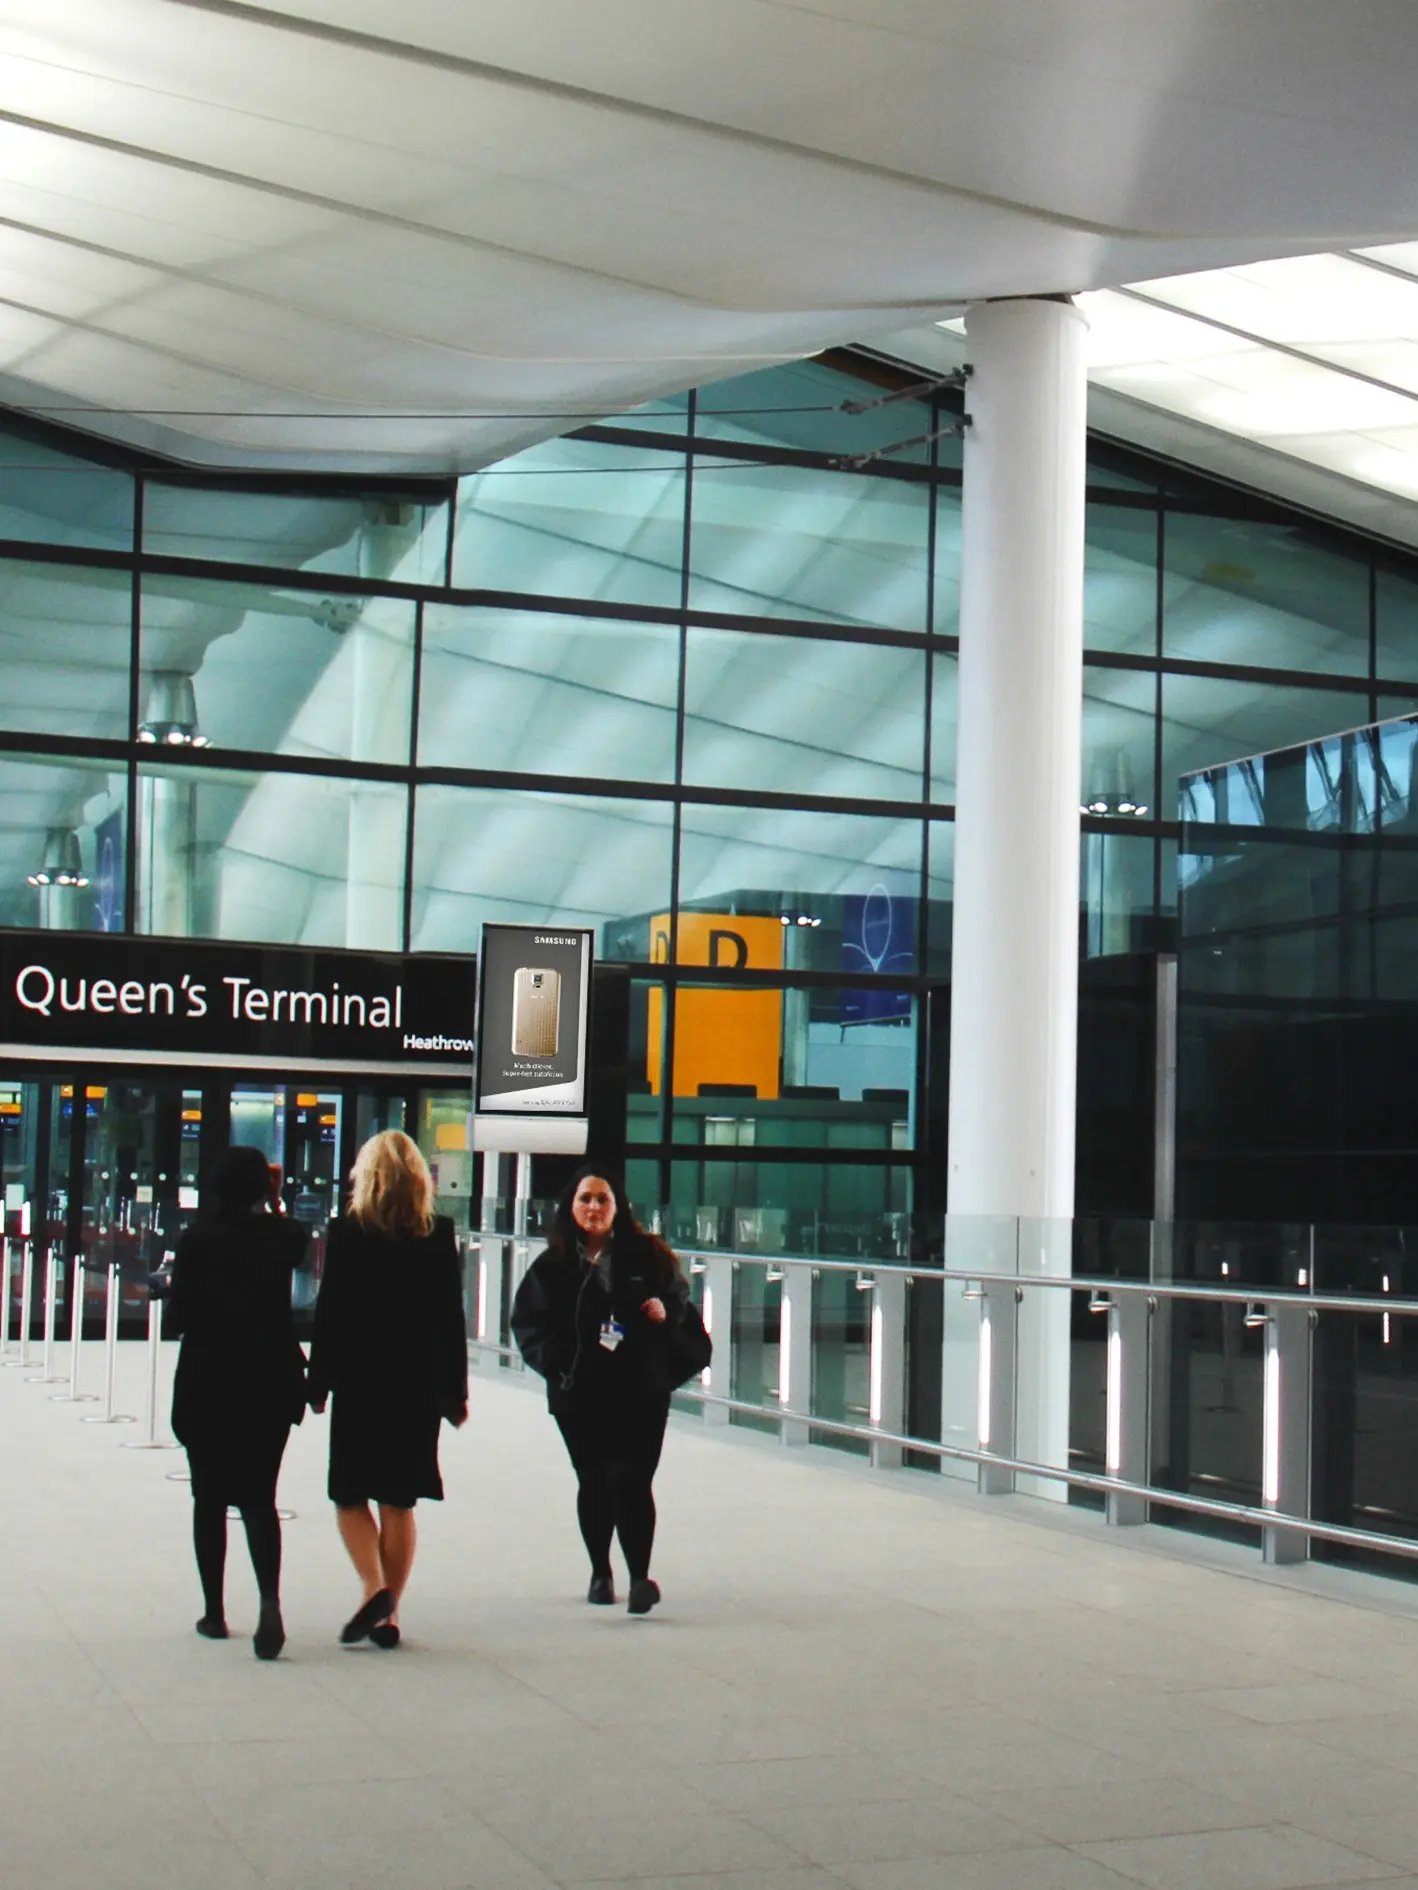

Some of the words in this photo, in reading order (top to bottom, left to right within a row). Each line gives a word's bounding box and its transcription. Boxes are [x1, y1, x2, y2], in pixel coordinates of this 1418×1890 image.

[534, 936, 577, 946] SAMSUNG
[15, 965, 208, 1017] Queen's
[222, 976, 402, 1028] Terminal
